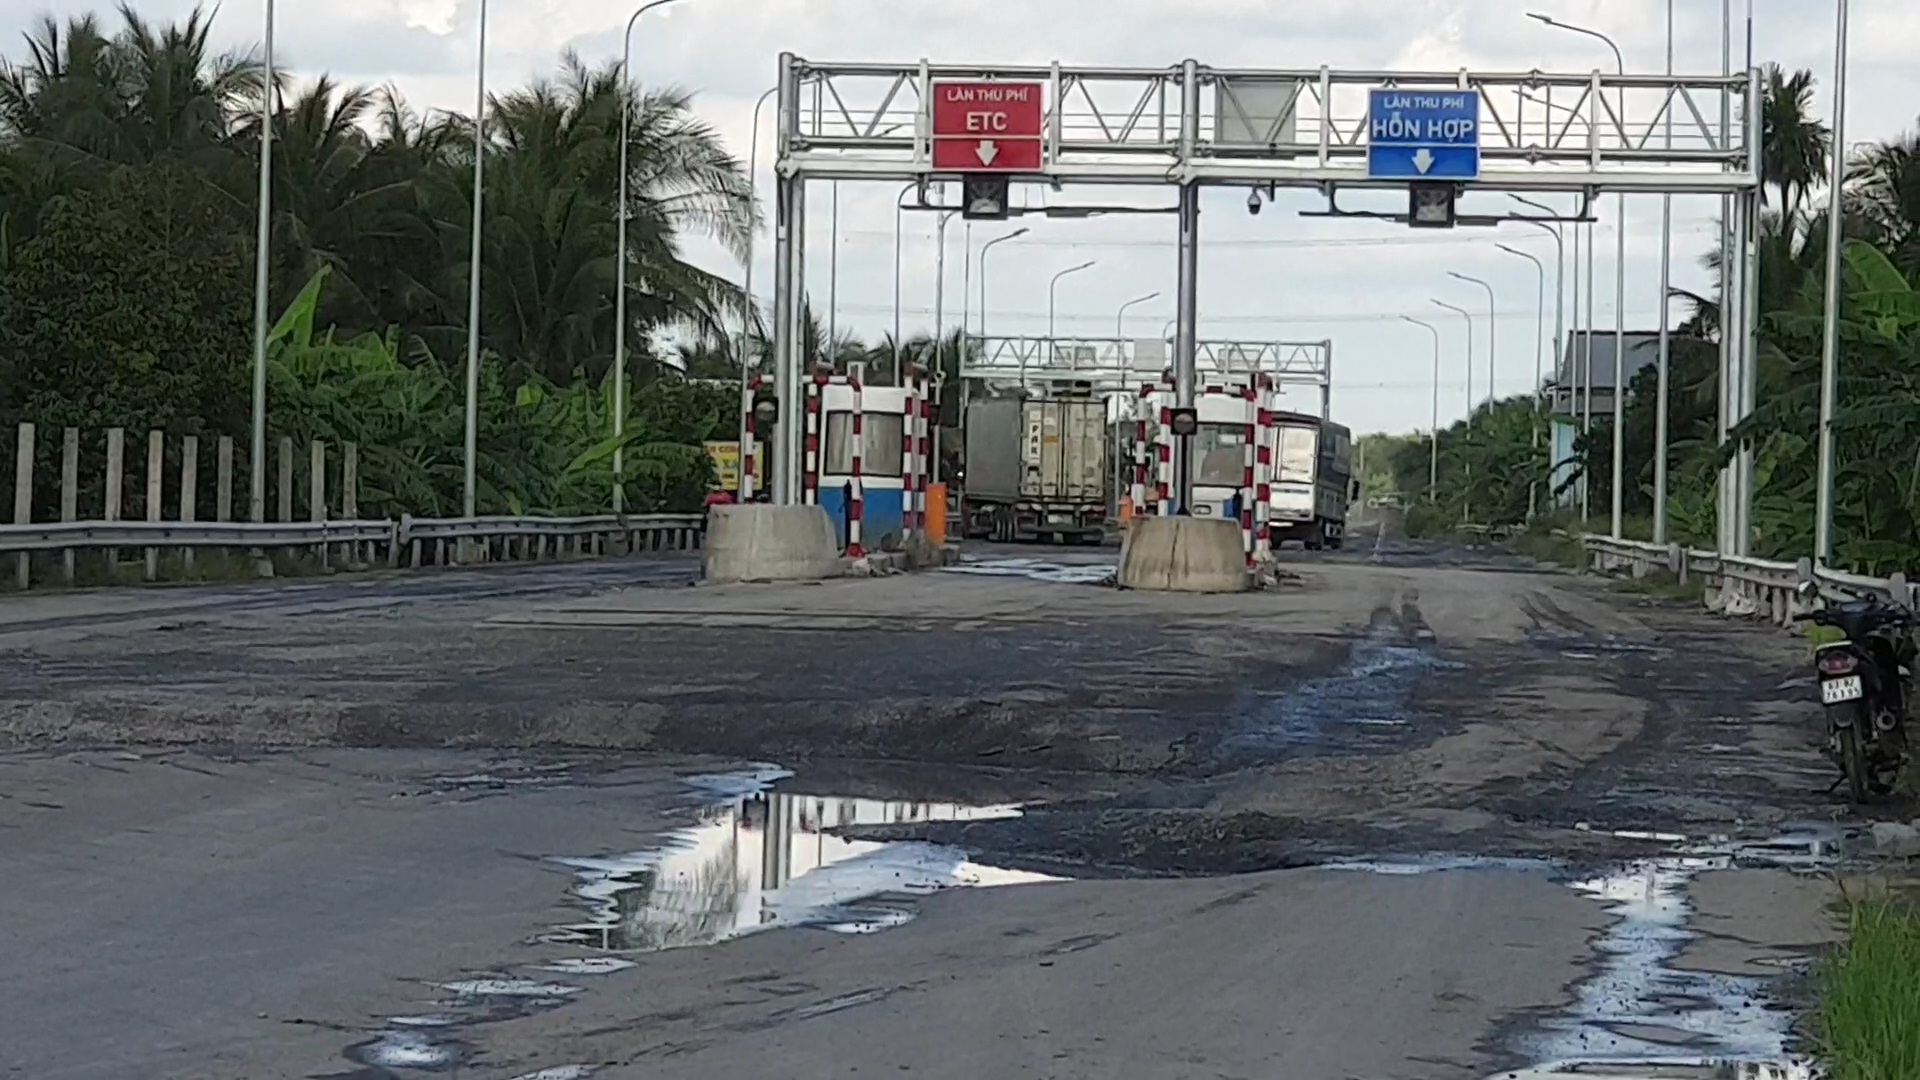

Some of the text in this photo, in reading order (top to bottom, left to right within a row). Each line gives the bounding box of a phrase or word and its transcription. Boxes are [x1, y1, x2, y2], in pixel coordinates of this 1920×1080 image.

[977, 89, 1003, 102] THU
[1006, 87, 1029, 102] PHÍ
[1413, 96, 1440, 109] THU
[1442, 94, 1465, 109] PHÍ
[966, 111, 1008, 131] ETC
[1372, 111, 1475, 143] HỖN HỢP
